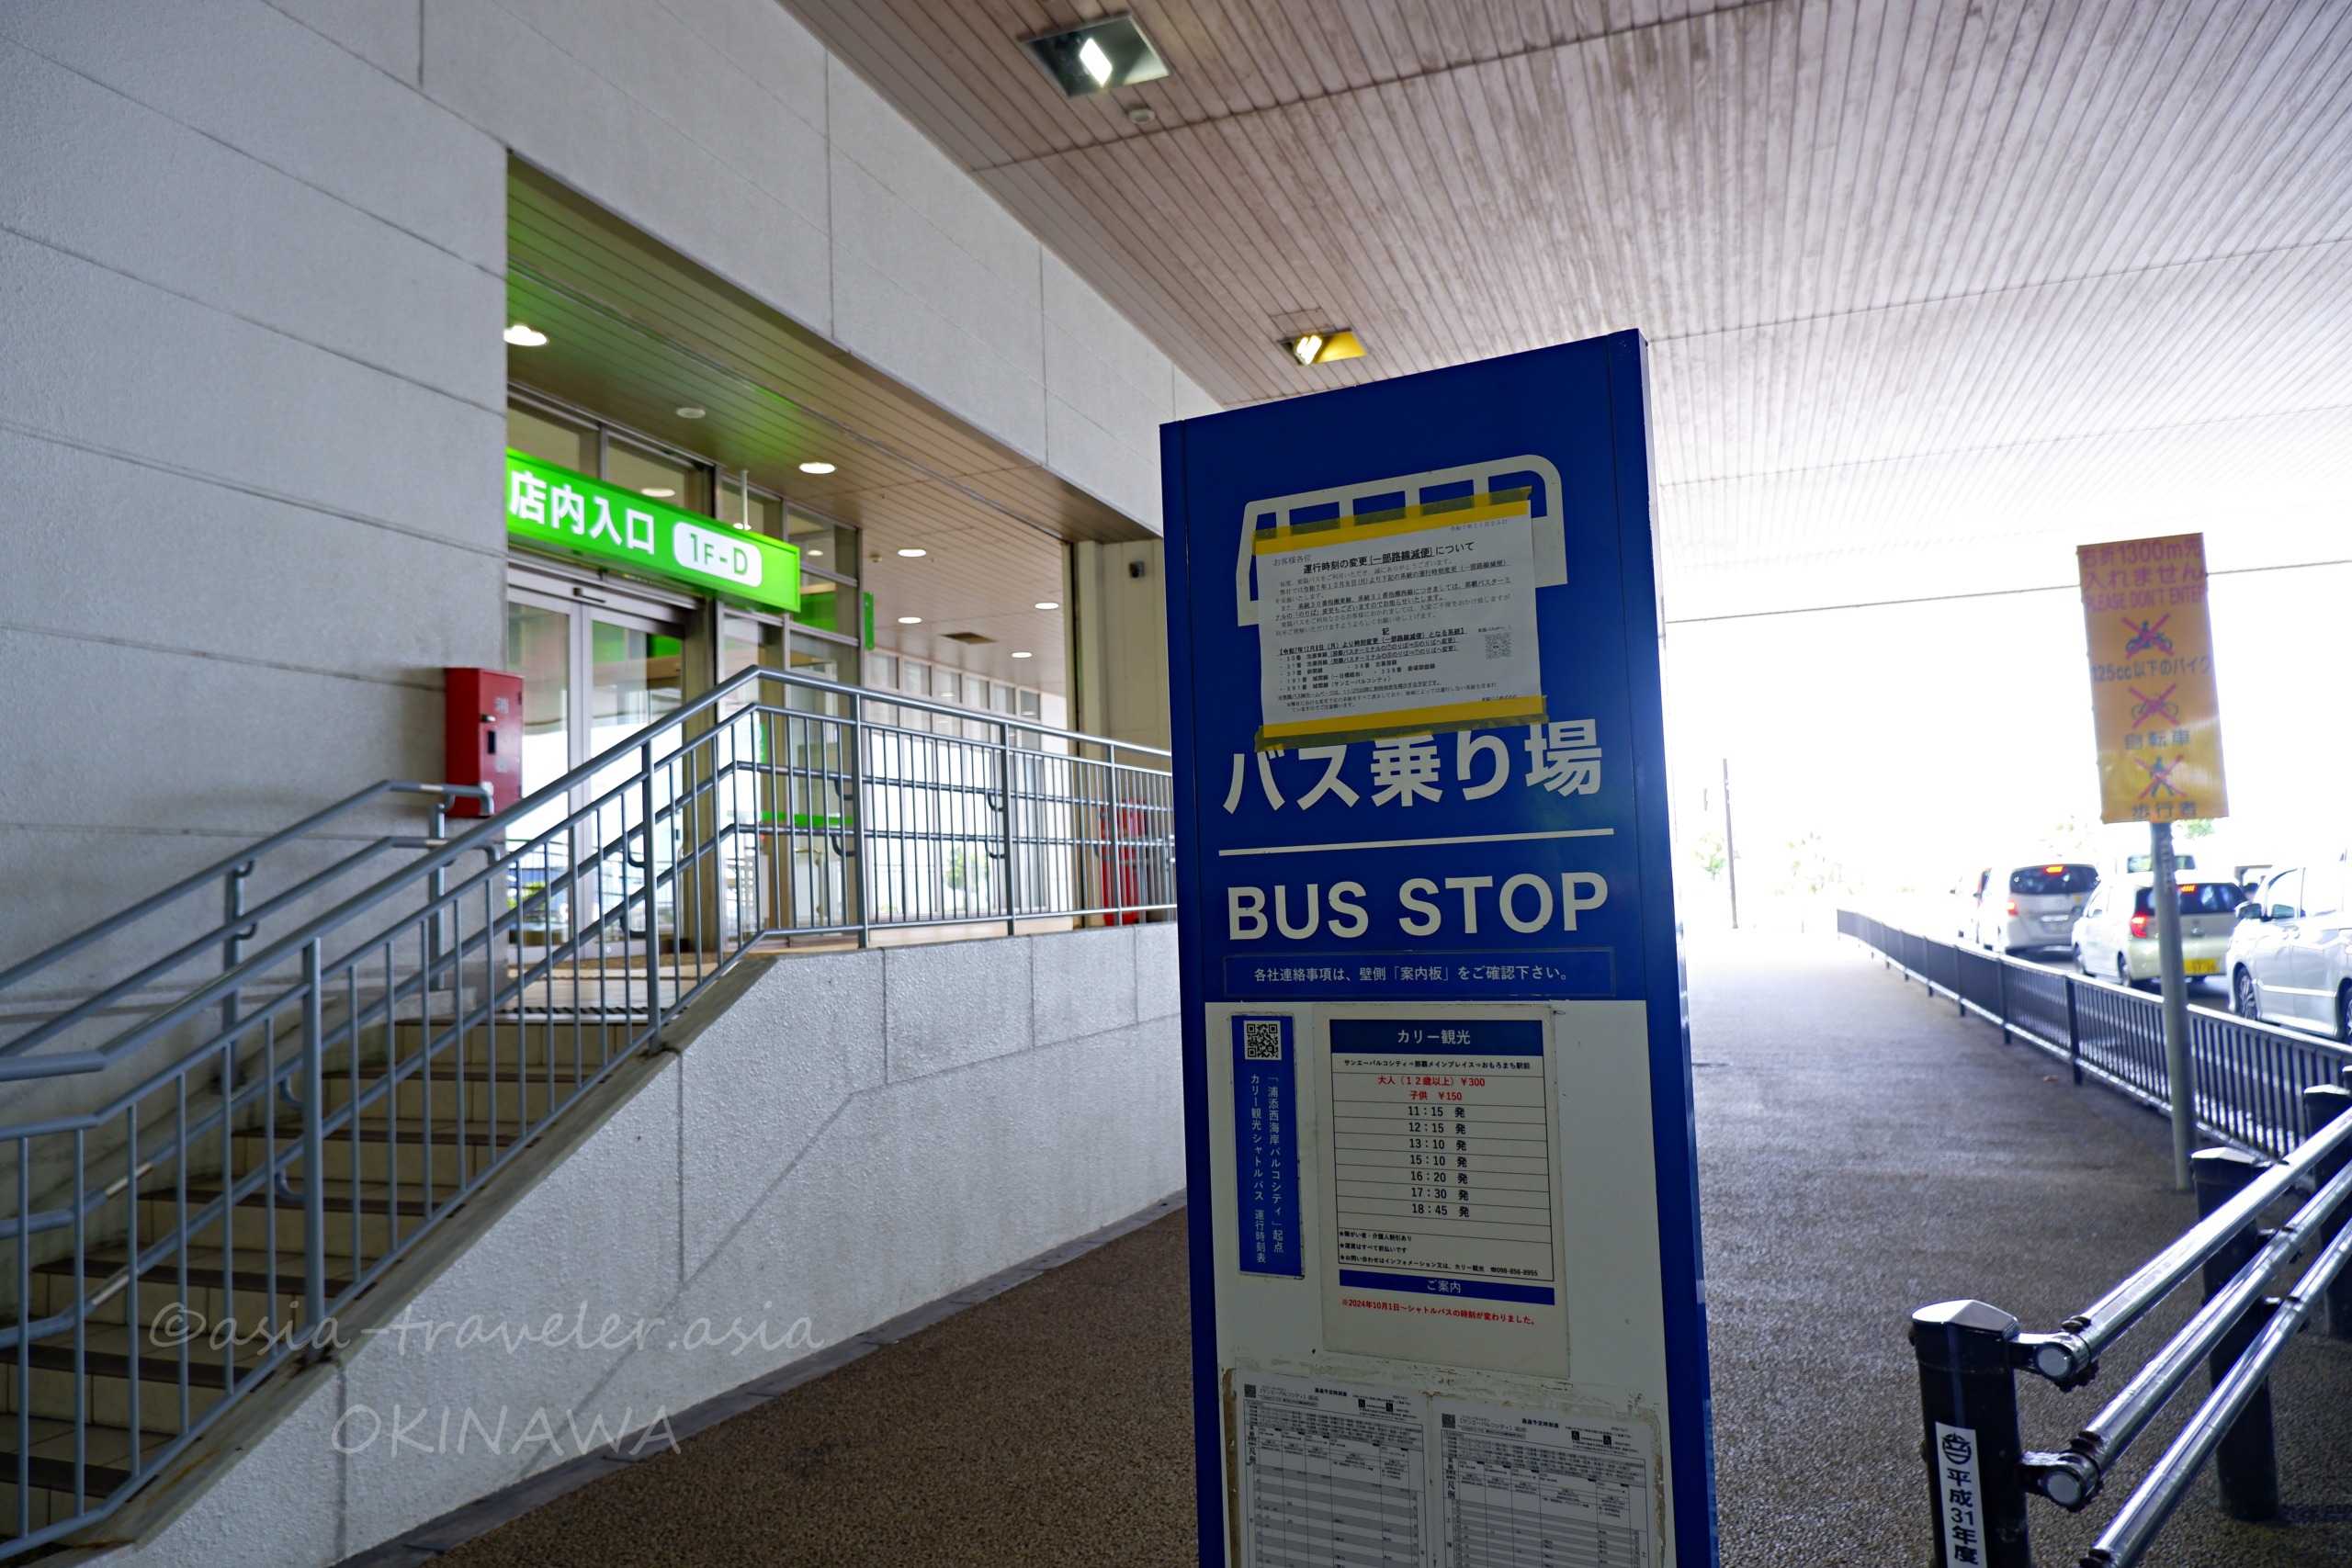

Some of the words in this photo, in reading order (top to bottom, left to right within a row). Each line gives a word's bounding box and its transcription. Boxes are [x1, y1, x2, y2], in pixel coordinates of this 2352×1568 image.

[509, 470, 655, 555] 店内入口
[690, 534, 748, 575] 1F-D
[1273, 554, 1312, 567] お客様各位
[2085, 562, 2203, 591] 入れません
[2085, 592, 2127, 613] PLEASE
[2131, 588, 2164, 608] DON'T
[1382, 627, 1390, 636] 記
[2091, 657, 2211, 682] 125cc以下のバイク
[2125, 729, 2191, 750] 自転車
[1223, 719, 1602, 814] バス乗り場
[2132, 801, 2198, 818] 歩行者
[1227, 881, 1369, 940] BUS
[1399, 872, 1608, 936] STOP
[1254, 965, 1567, 982] 各社連絡事項は、壁側「案内板」をご確認下さい。
[1397, 1030, 1471, 1044] カリー観光
[1410, 1090, 1428, 1100] 子供
[1408, 1106, 1443, 1117] 11：15
[1455, 1107, 1465, 1118] 発
[1408, 1122, 1444, 1134] 12：15
[1455, 1122, 1466, 1134] 発
[1409, 1139, 1445, 1150] 13：10
[1456, 1139, 1467, 1151] 発
[1409, 1155, 1446, 1167] 15：10
[1457, 1156, 1467, 1168] 発
[1410, 1171, 1447, 1183] 16：20
[1457, 1172, 1468, 1184] 発
[1411, 1188, 1447, 1200] 17：30
[1458, 1189, 1469, 1201] 発
[1411, 1203, 1448, 1216] 18：45
[1459, 1205, 1470, 1218] 発
[1255, 1209, 1266, 1263] 運行時刻表
[1427, 1279, 1462, 1294] ご案内
[1946, 1468, 1978, 1565] 平成31年度
